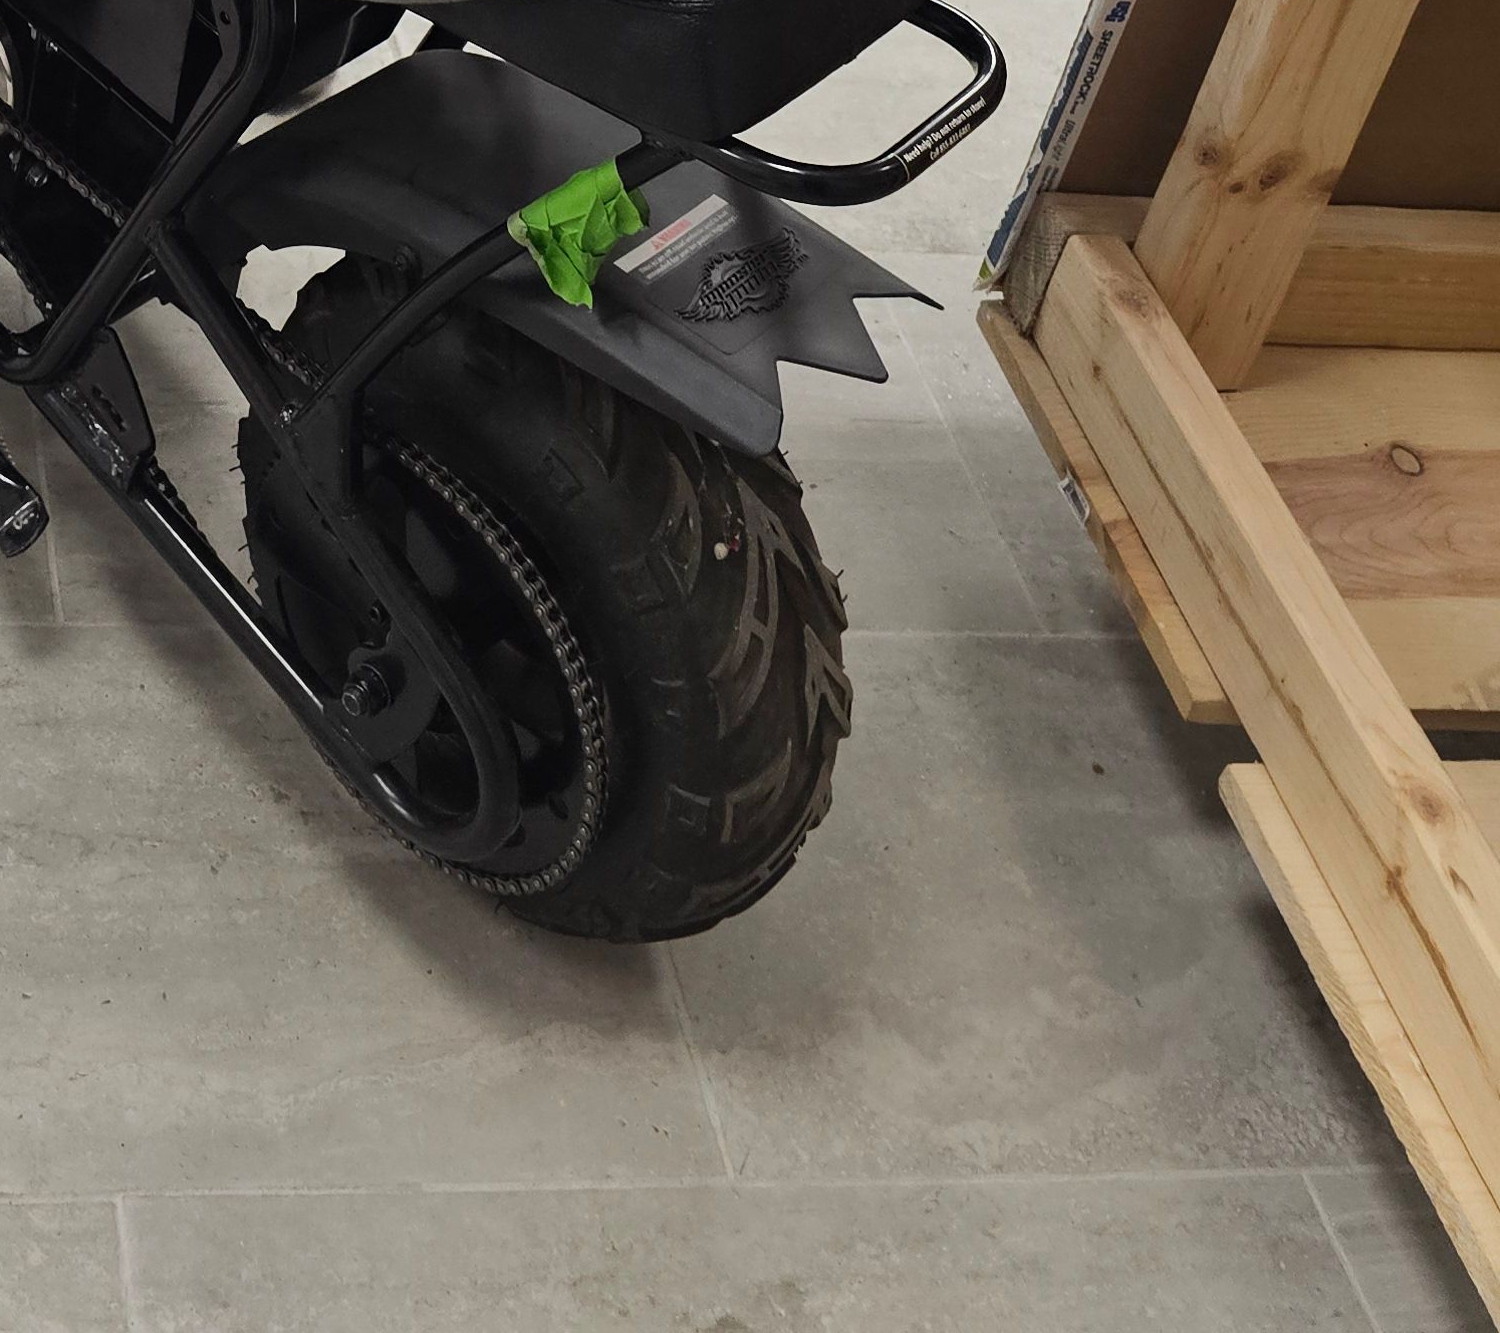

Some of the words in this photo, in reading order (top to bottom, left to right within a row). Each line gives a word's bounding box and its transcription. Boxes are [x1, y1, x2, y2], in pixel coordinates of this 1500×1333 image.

[903, 146, 921, 163] Need
[915, 135, 935, 153] help?
[930, 131, 942, 142] Do
[940, 124, 951, 137] not
[949, 113, 967, 130] return
[969, 95, 987, 114] store!
